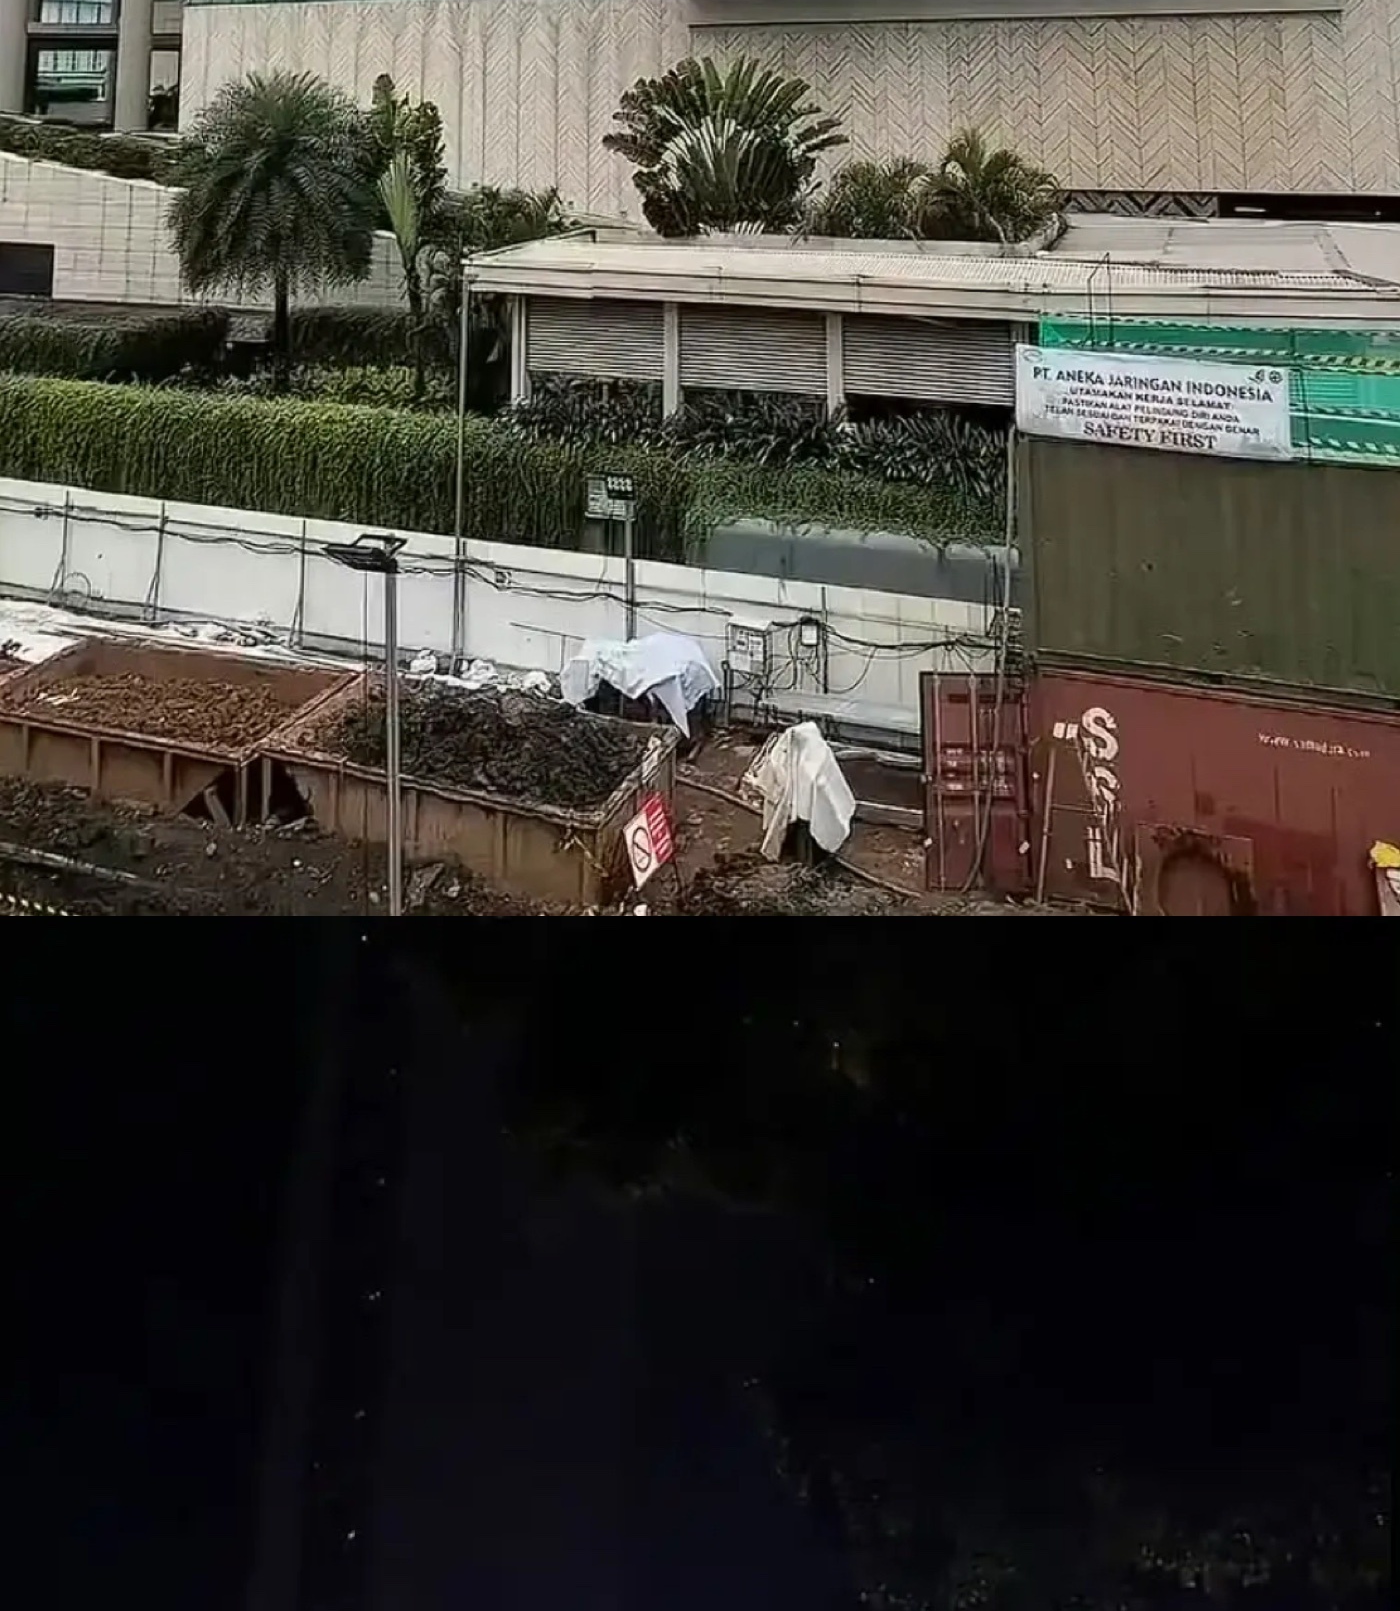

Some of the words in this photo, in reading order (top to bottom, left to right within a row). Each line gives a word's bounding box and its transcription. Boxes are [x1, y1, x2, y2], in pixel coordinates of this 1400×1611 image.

[1056, 369, 1105, 386] ANEKA
[1107, 374, 1182, 393] JARINGAN
[1186, 381, 1274, 403] INDONESIA
[1069, 386, 1132, 400] UTAMAKAN
[1135, 393, 1174, 405] KERJA
[1062, 397, 1108, 409] PASTIKAN
[1083, 421, 1156, 443] SAFETY
[1159, 431, 1218, 449] FIRST
